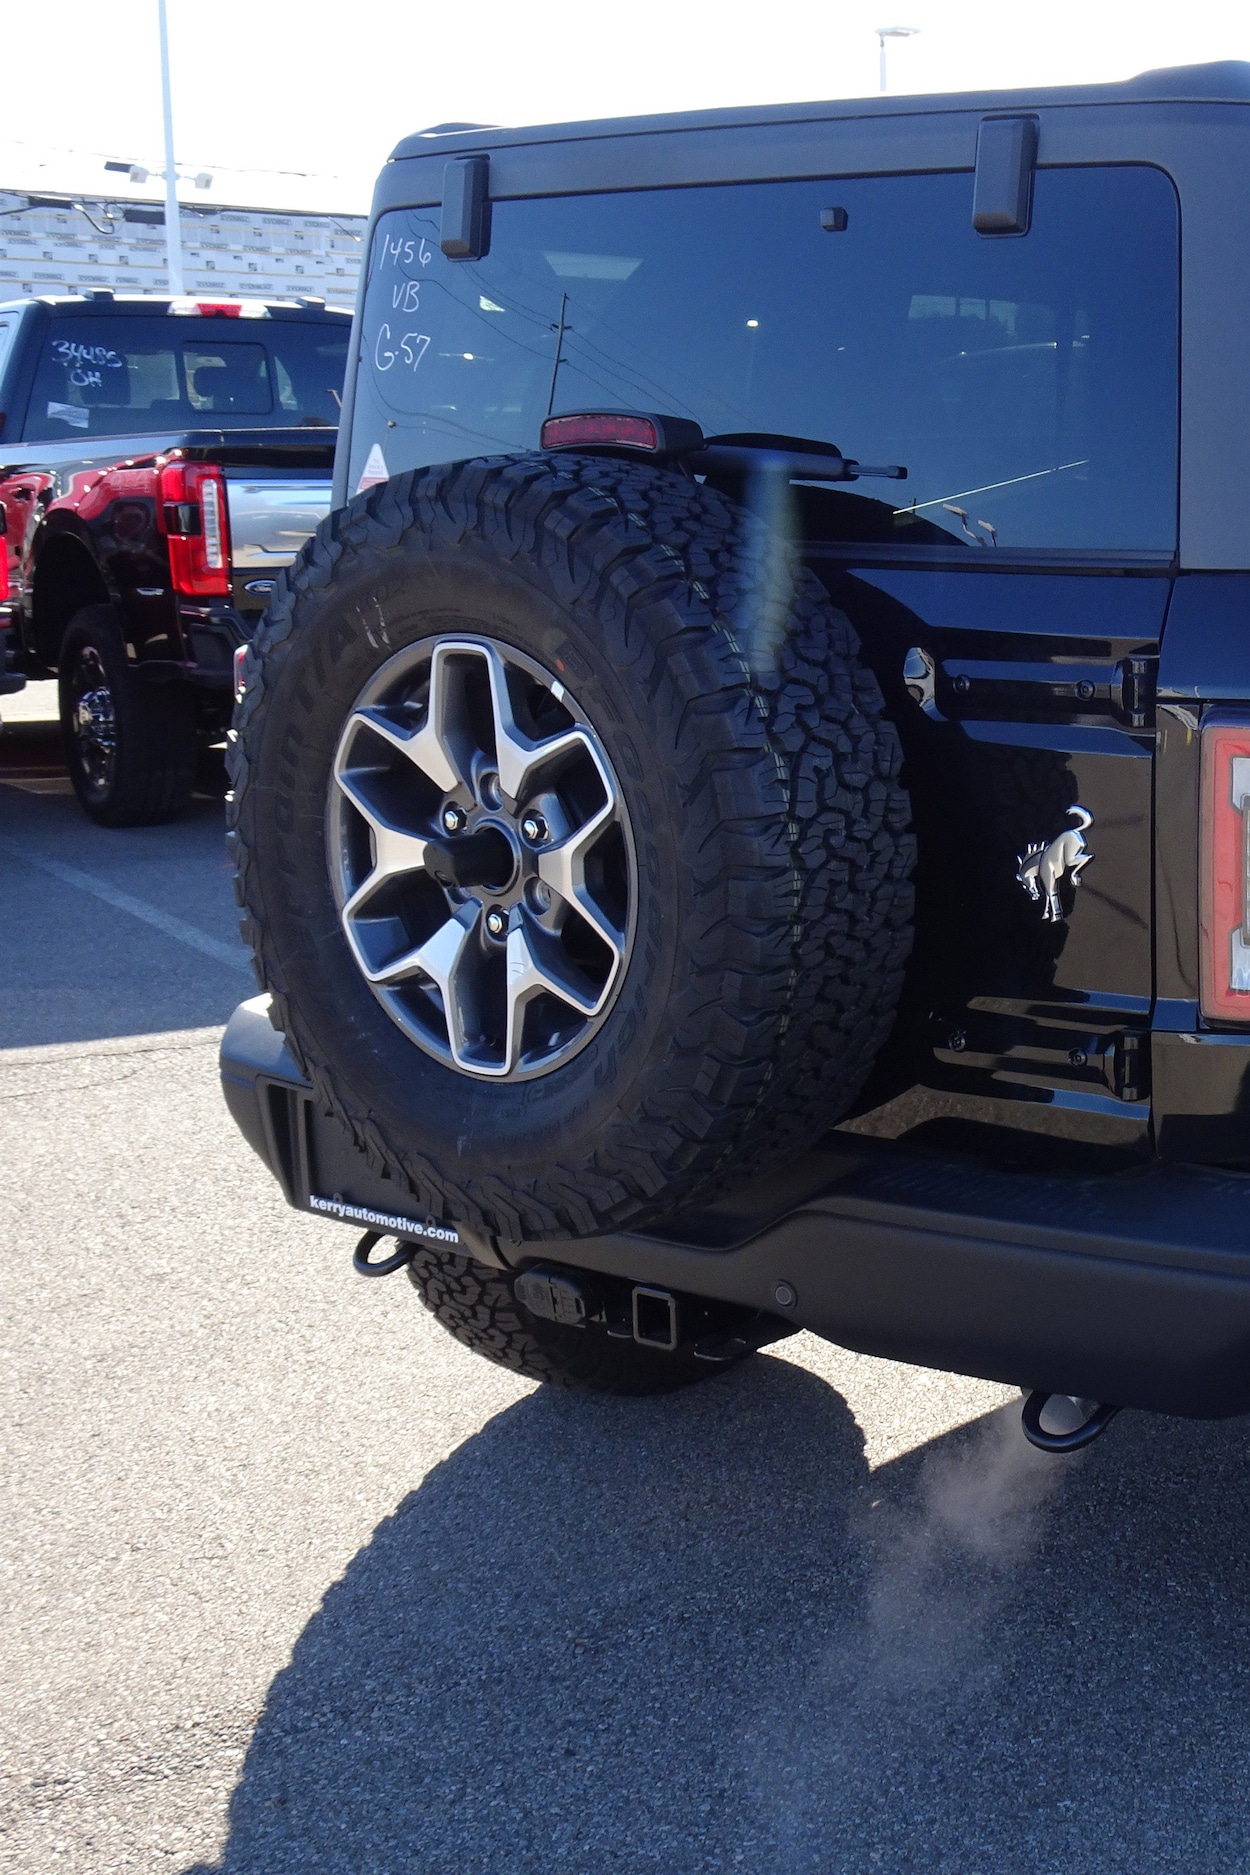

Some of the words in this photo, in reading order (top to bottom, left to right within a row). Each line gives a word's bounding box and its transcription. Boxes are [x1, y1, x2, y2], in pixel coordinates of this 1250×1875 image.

[379, 233, 432, 270] 1456
[391, 280, 420, 313] VB
[309, 1194, 460, 1244] kerryautomotive.com
